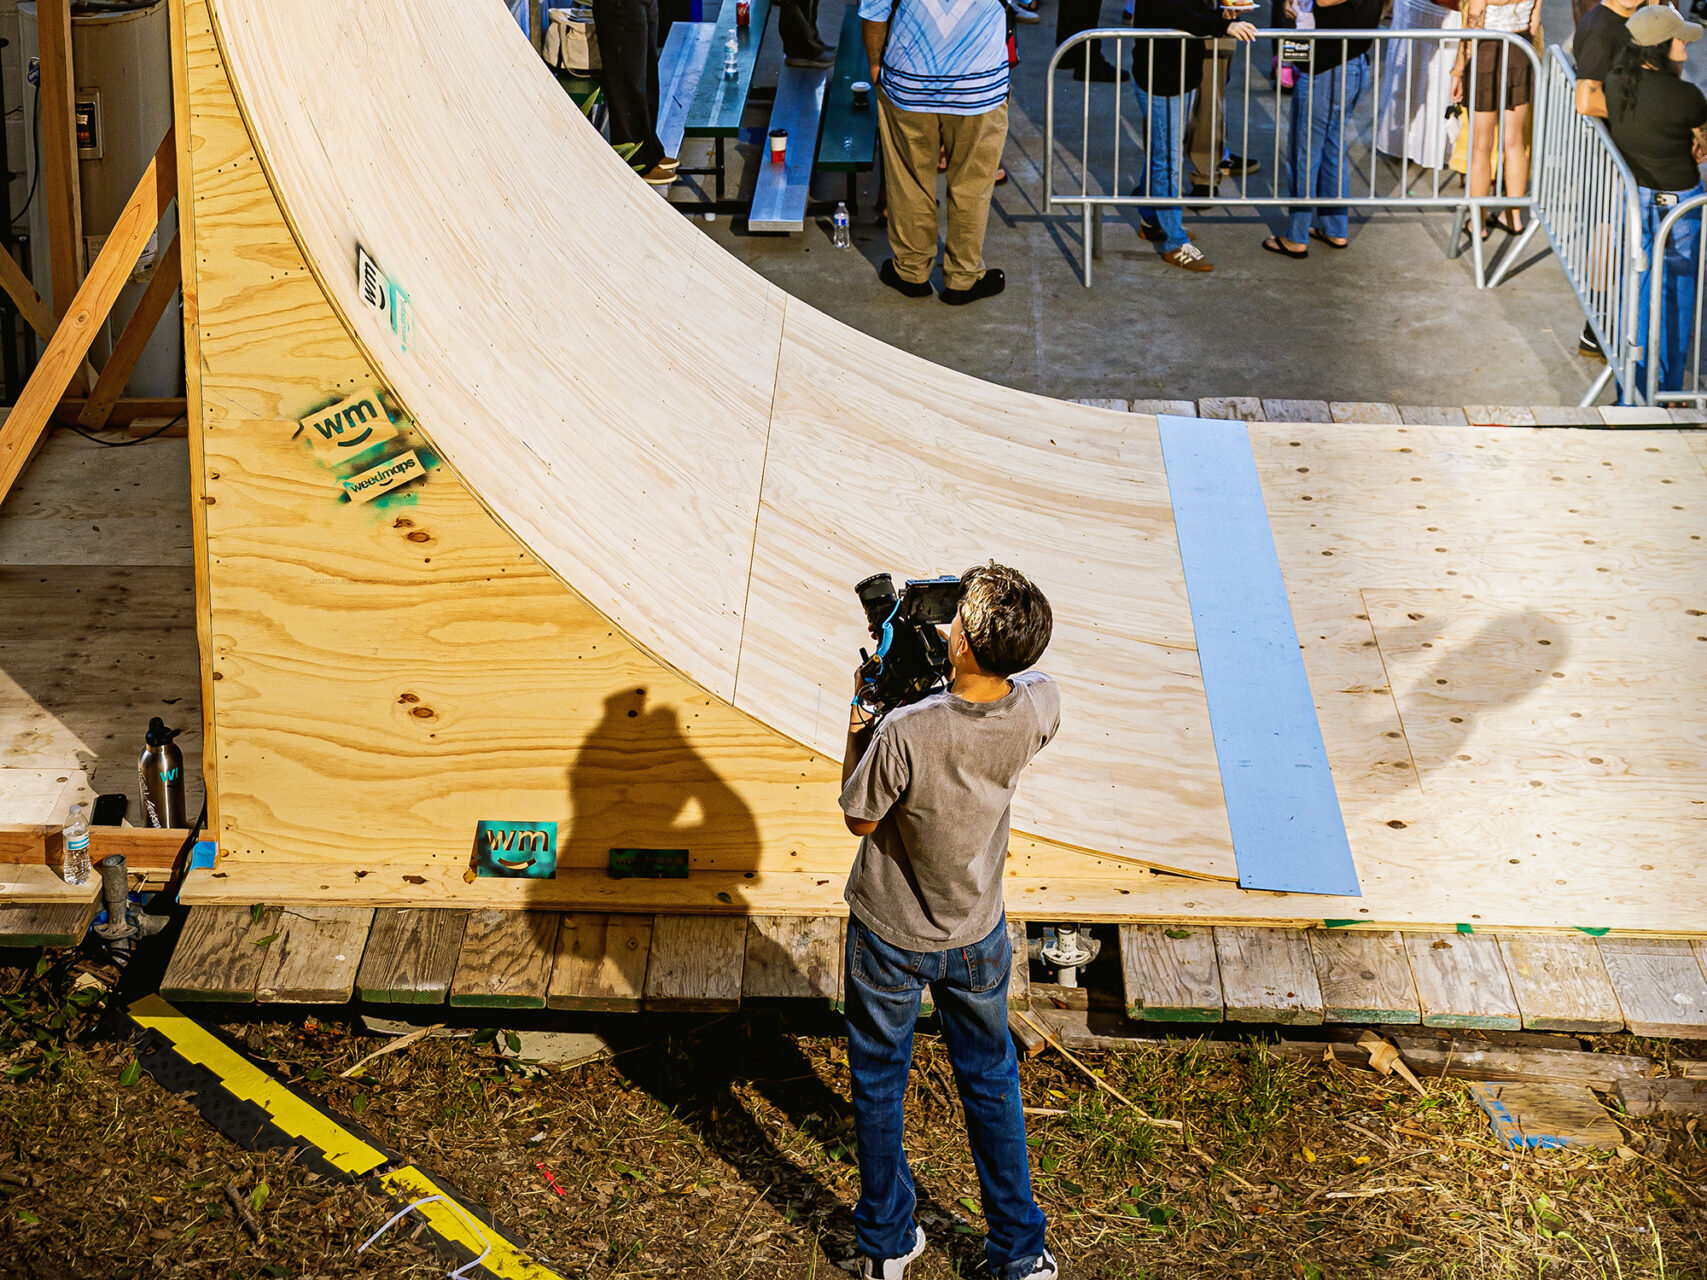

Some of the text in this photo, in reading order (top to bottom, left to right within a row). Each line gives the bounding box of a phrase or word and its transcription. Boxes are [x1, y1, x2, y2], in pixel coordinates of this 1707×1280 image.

[364, 261, 377, 307] wm
[313, 400, 378, 439] wm
[351, 458, 416, 493] weedmaps
[487, 830, 549, 852] wm
